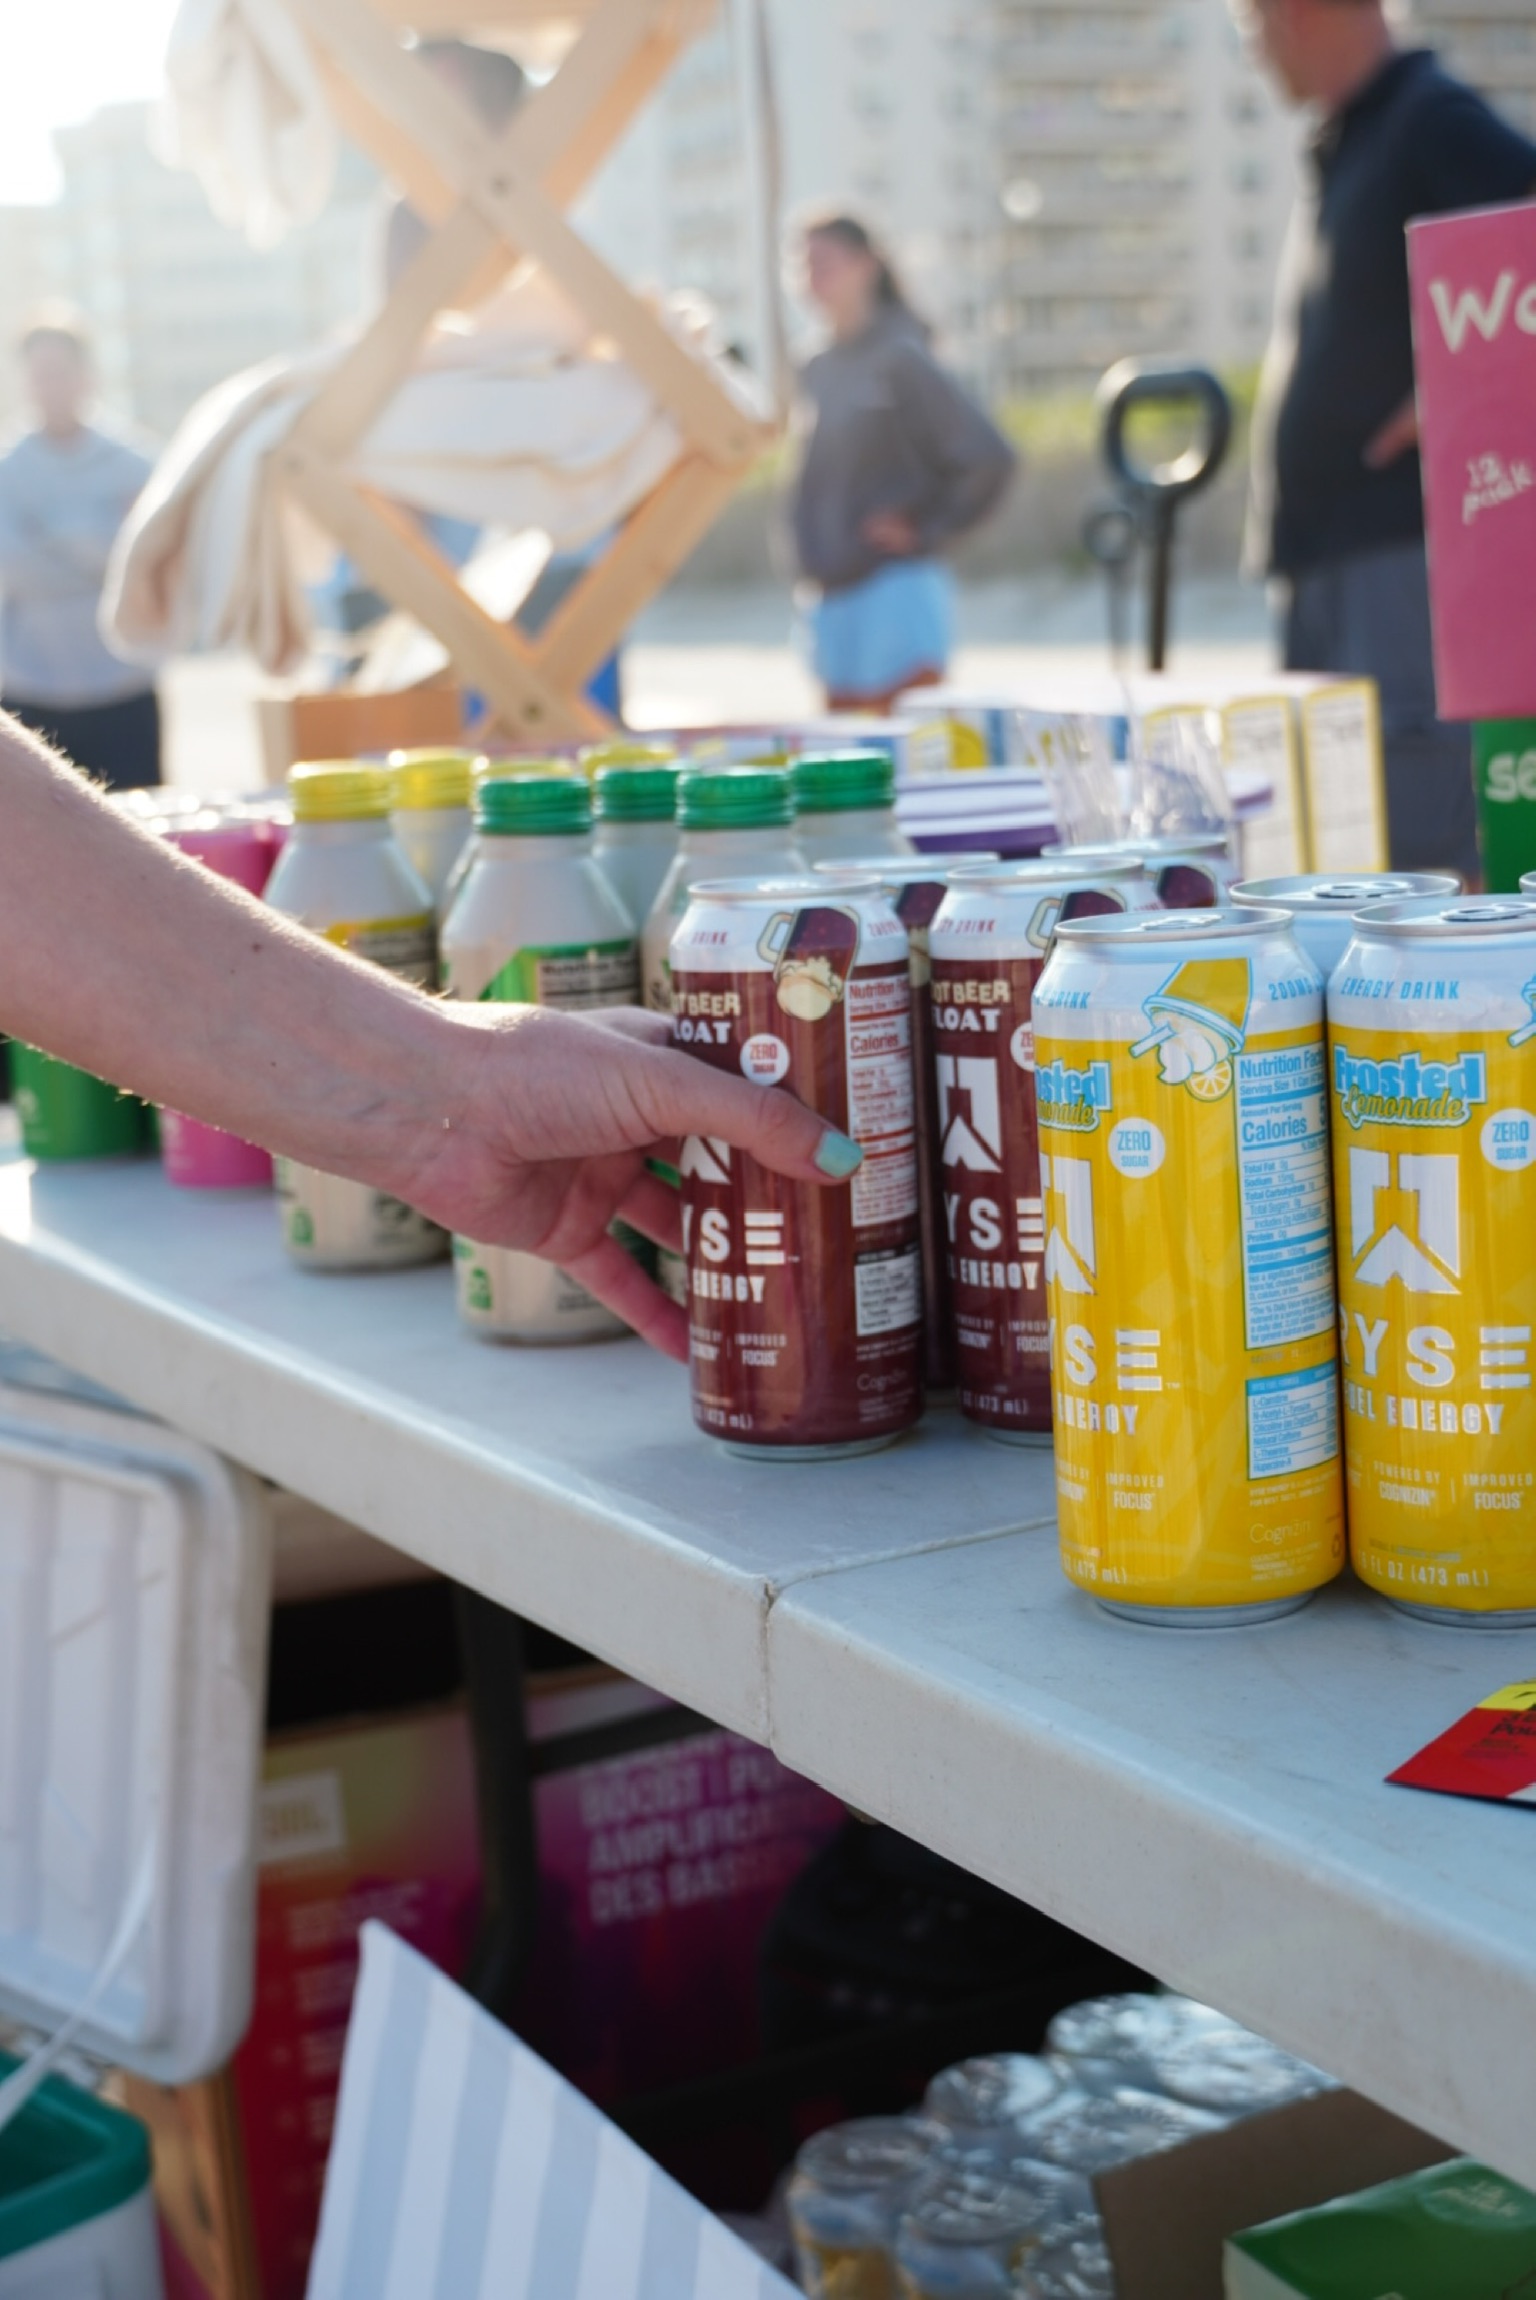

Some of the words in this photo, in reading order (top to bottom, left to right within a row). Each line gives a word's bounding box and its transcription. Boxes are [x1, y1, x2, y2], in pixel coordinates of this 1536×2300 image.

[850, 982, 895, 999] Nutrition
[953, 979, 1012, 1005] BEER
[1340, 977, 1393, 1000] ENERGY
[1400, 979, 1460, 1001] DRINK
[687, 991, 741, 1017] BEER
[750, 1044, 778, 1060] ZERO
[850, 1032, 899, 1053] Calories
[1239, 1053, 1302, 1079] Nutrition
[1333, 1048, 1485, 1104] Frosted
[1344, 1083, 1467, 1124] Lemonade
[1242, 1115, 1307, 1143] Calories
[1491, 1120, 1530, 1142] ZERO
[1117, 1130, 1151, 1151] ZERO
[1121, 1155, 1150, 1168] SUGAR
[1244, 1164, 1263, 1174] Total
[959, 1258, 1040, 1291] ENERGY
[1386, 1395, 1504, 1434] ENERGY
[1106, 1472, 1165, 1488] IMPROVED
[1374, 1460, 1421, 1482] POWERED
[1463, 1472, 1533, 1487] IMPROVED
[1113, 1490, 1153, 1511] FOCUS
[1474, 1491, 1522, 1510] FOCUS
[1387, 1560, 1404, 1581] OZ
[1411, 1564, 1448, 1586] (473
[1456, 1568, 1489, 1587] mL)
